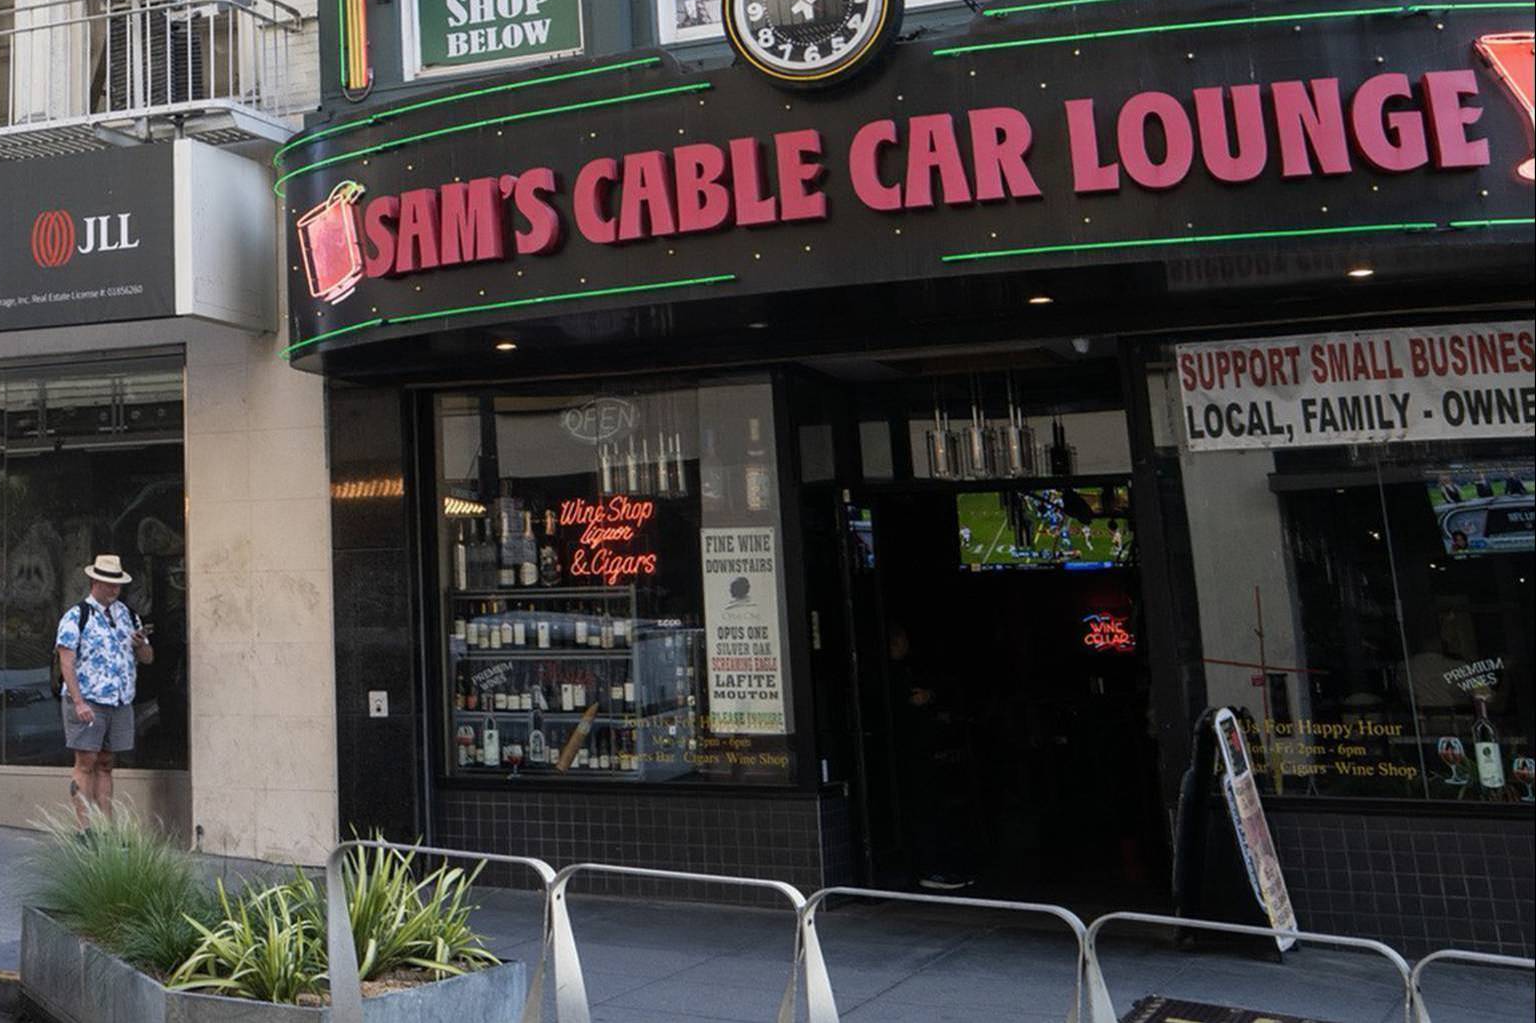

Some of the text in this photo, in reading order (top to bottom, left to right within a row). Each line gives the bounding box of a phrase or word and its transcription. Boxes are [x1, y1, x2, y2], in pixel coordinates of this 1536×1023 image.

[747, 2, 763, 21] 9
[847, 13, 863, 32] 4
[446, 18, 552, 58] BELOW
[758, 28, 775, 48] 8
[831, 37, 848, 54] 5
[778, 43, 793, 62] 7
[804, 45, 821, 63] 6
[364, 69, 1491, 278] SAM'S CABLE CAR LOUNGE
[78, 212, 141, 254] JLL
[1180, 346, 1301, 392] SUPPORT
[1310, 339, 1404, 384] SMALL
[564, 404, 635, 433] OPEN
[1185, 387, 1535, 442] LOCAL, FAMILY - OWNE
[560, 496, 653, 527] Wine Shop
[705, 534, 771, 553] FINE WINE
[591, 548, 657, 585] Cigars
[705, 558, 773, 574] DOWNSTAIRS
[717, 626, 769, 640] OPUS ONE
[1089, 621, 1124, 634] WINE
[716, 642, 772, 656] SILVER OAK
[471, 661, 513, 685] PREMIUM
[1443, 657, 1505, 684] PREMIUM
[714, 674, 776, 688] LAFITE
[1457, 672, 1498, 692] WINES
[713, 690, 779, 700] MOUTON
[1264, 719, 1293, 734] For
[1297, 719, 1353, 739] Happy
[1357, 719, 1403, 736] Hour
[1298, 742, 1326, 756] 2pm
[1337, 742, 1367, 759] 6pm
[1279, 762, 1327, 777] Cigars
[1334, 762, 1375, 776] Wine
[1378, 762, 1418, 780] Shop
